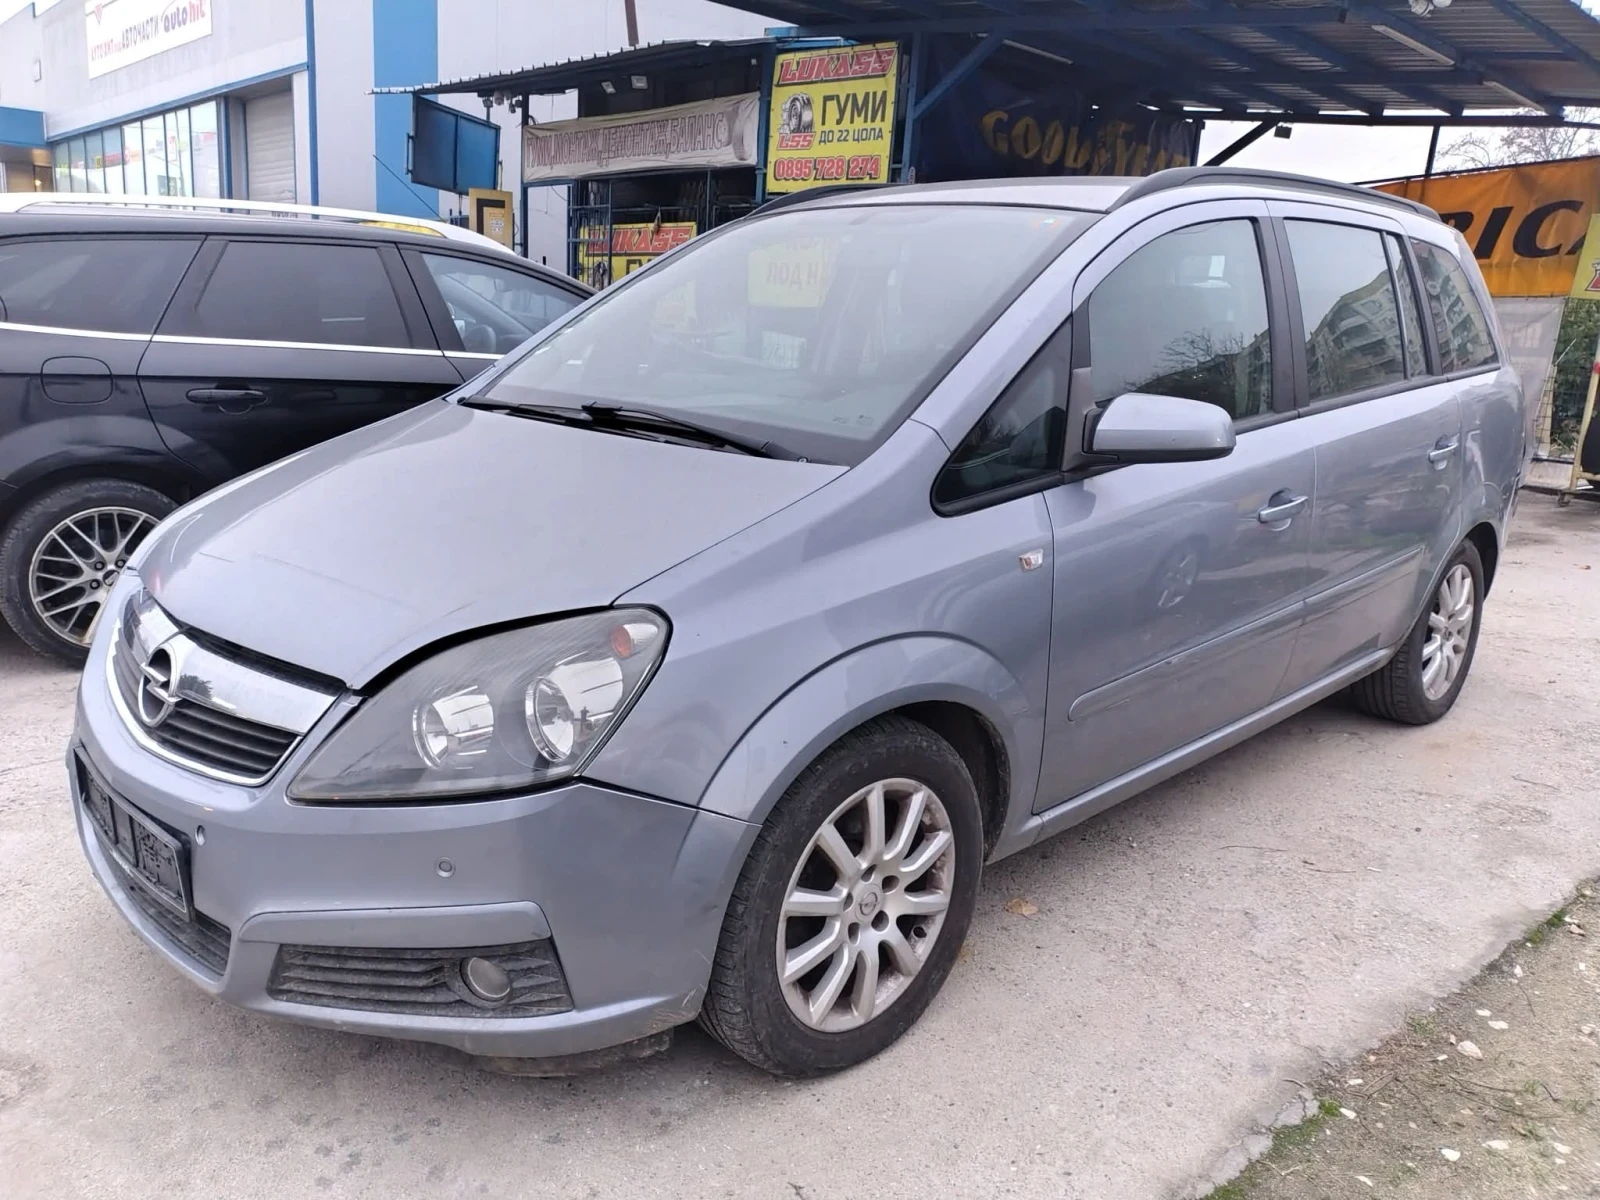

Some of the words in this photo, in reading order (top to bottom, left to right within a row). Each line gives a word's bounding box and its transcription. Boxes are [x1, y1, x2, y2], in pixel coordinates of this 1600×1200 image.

[121, 15, 159, 50] АВТОЧАСТИ
[777, 49, 896, 87] LUKASS
[821, 90, 888, 126] ГУМИ
[818, 130, 835, 146] ДО
[837, 129, 850, 143] 22
[852, 127, 884, 143] ЦОЛА
[774, 156, 814, 180] 0895
[815, 155, 848, 180] 728
[847, 154, 882, 180] 274
